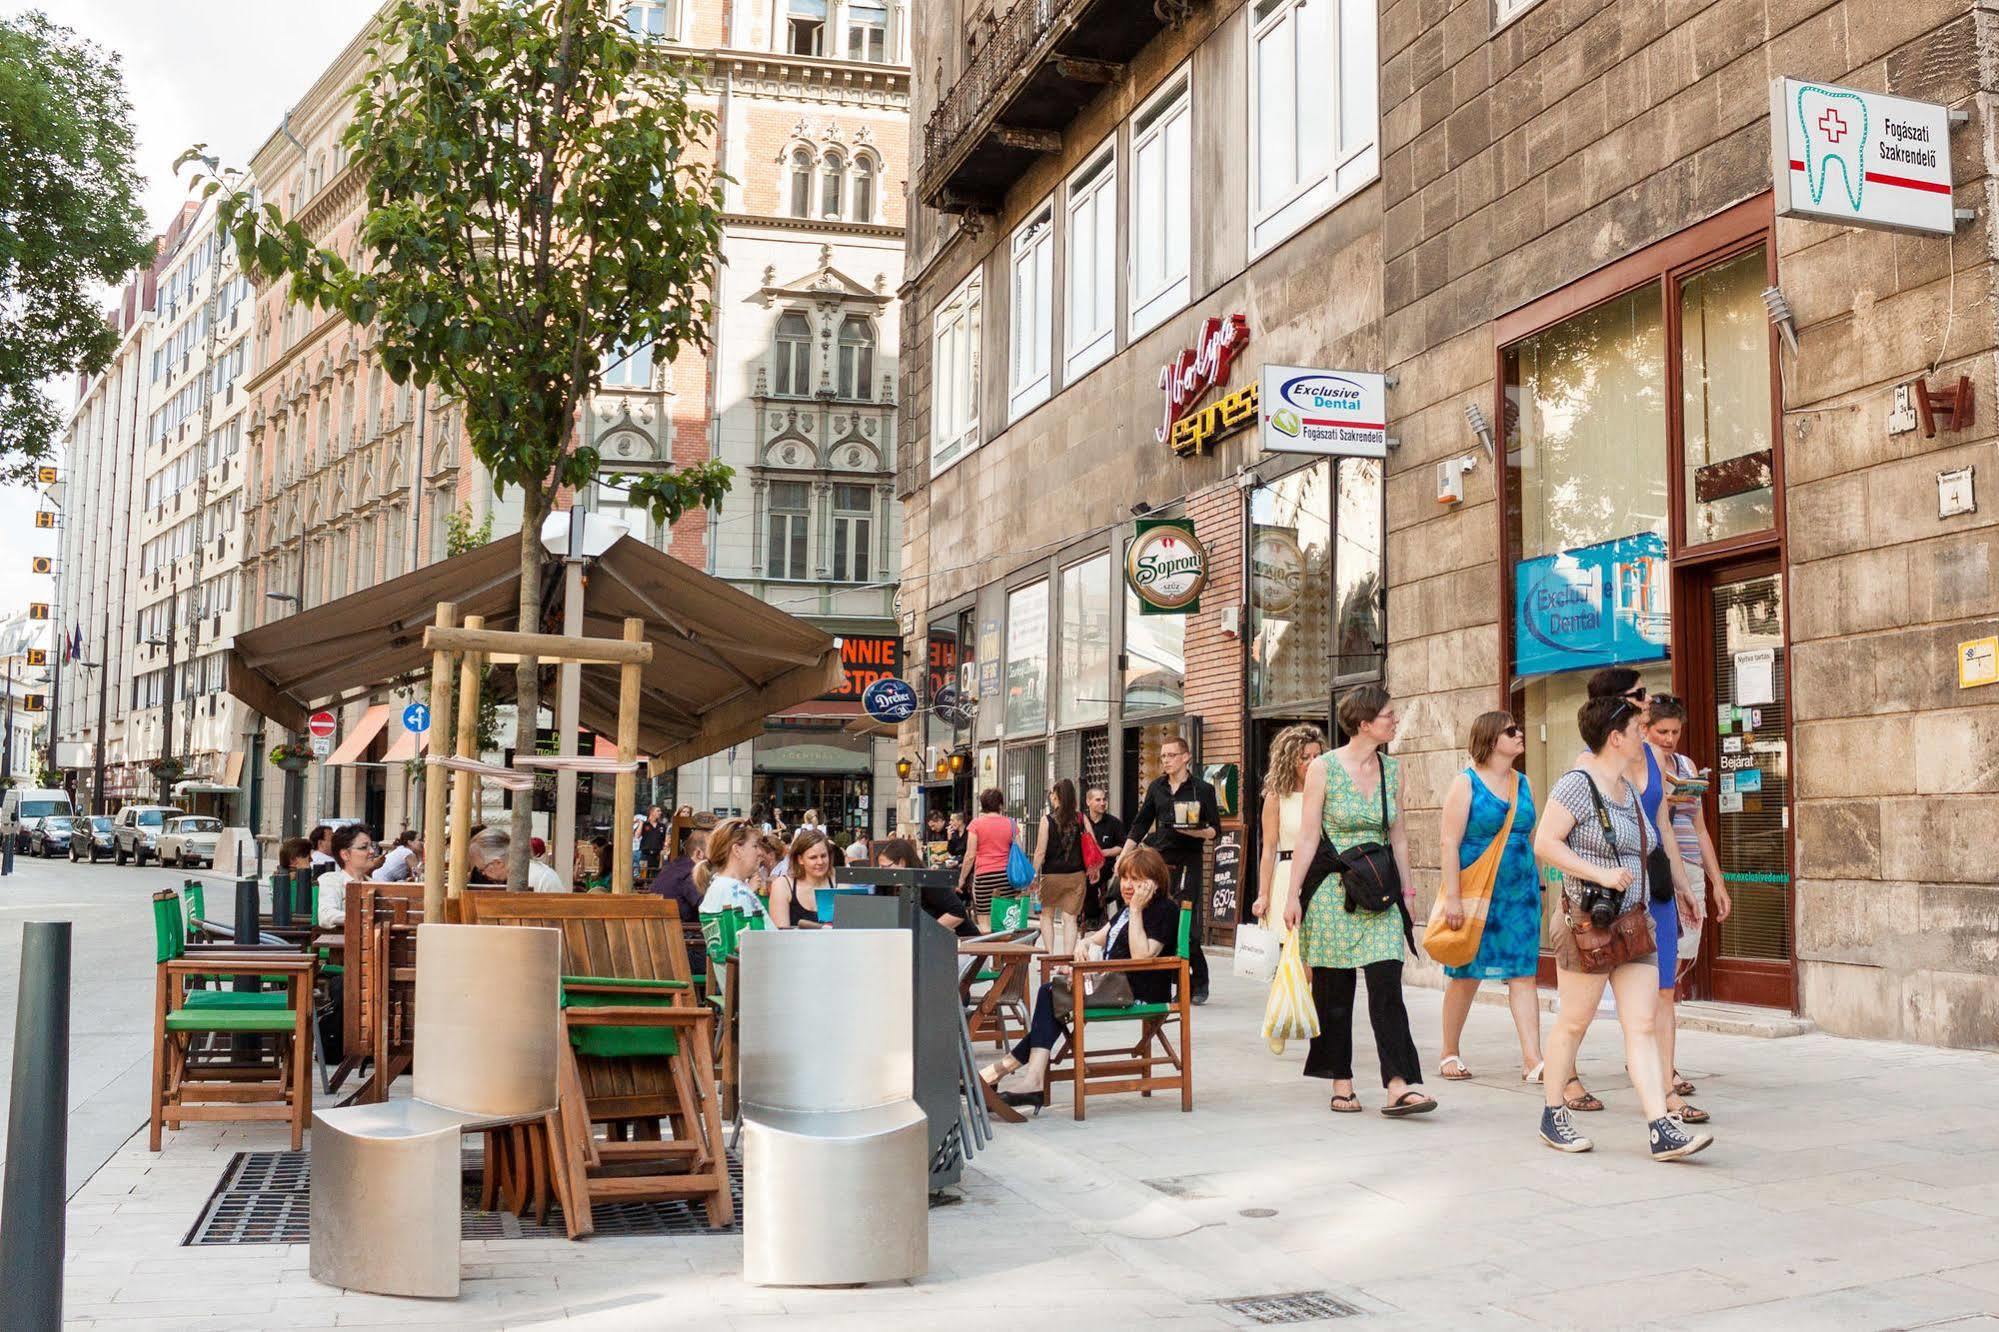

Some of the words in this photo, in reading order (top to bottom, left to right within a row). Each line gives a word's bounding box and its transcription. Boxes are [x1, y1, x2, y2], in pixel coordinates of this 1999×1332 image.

[1885, 118, 1930, 143] Fogászati
[1879, 141, 1936, 168] Szakrendelő
[1293, 384, 1360, 399] Exclusive
[1314, 396, 1361, 410] Dental
[1303, 426, 1338, 441] Fogászati
[1136, 551, 1202, 585] Soproni
[1551, 610, 1600, 635] Dental
[875, 691, 911, 708] Dreher
[1720, 754, 1754, 770] Bejárat
